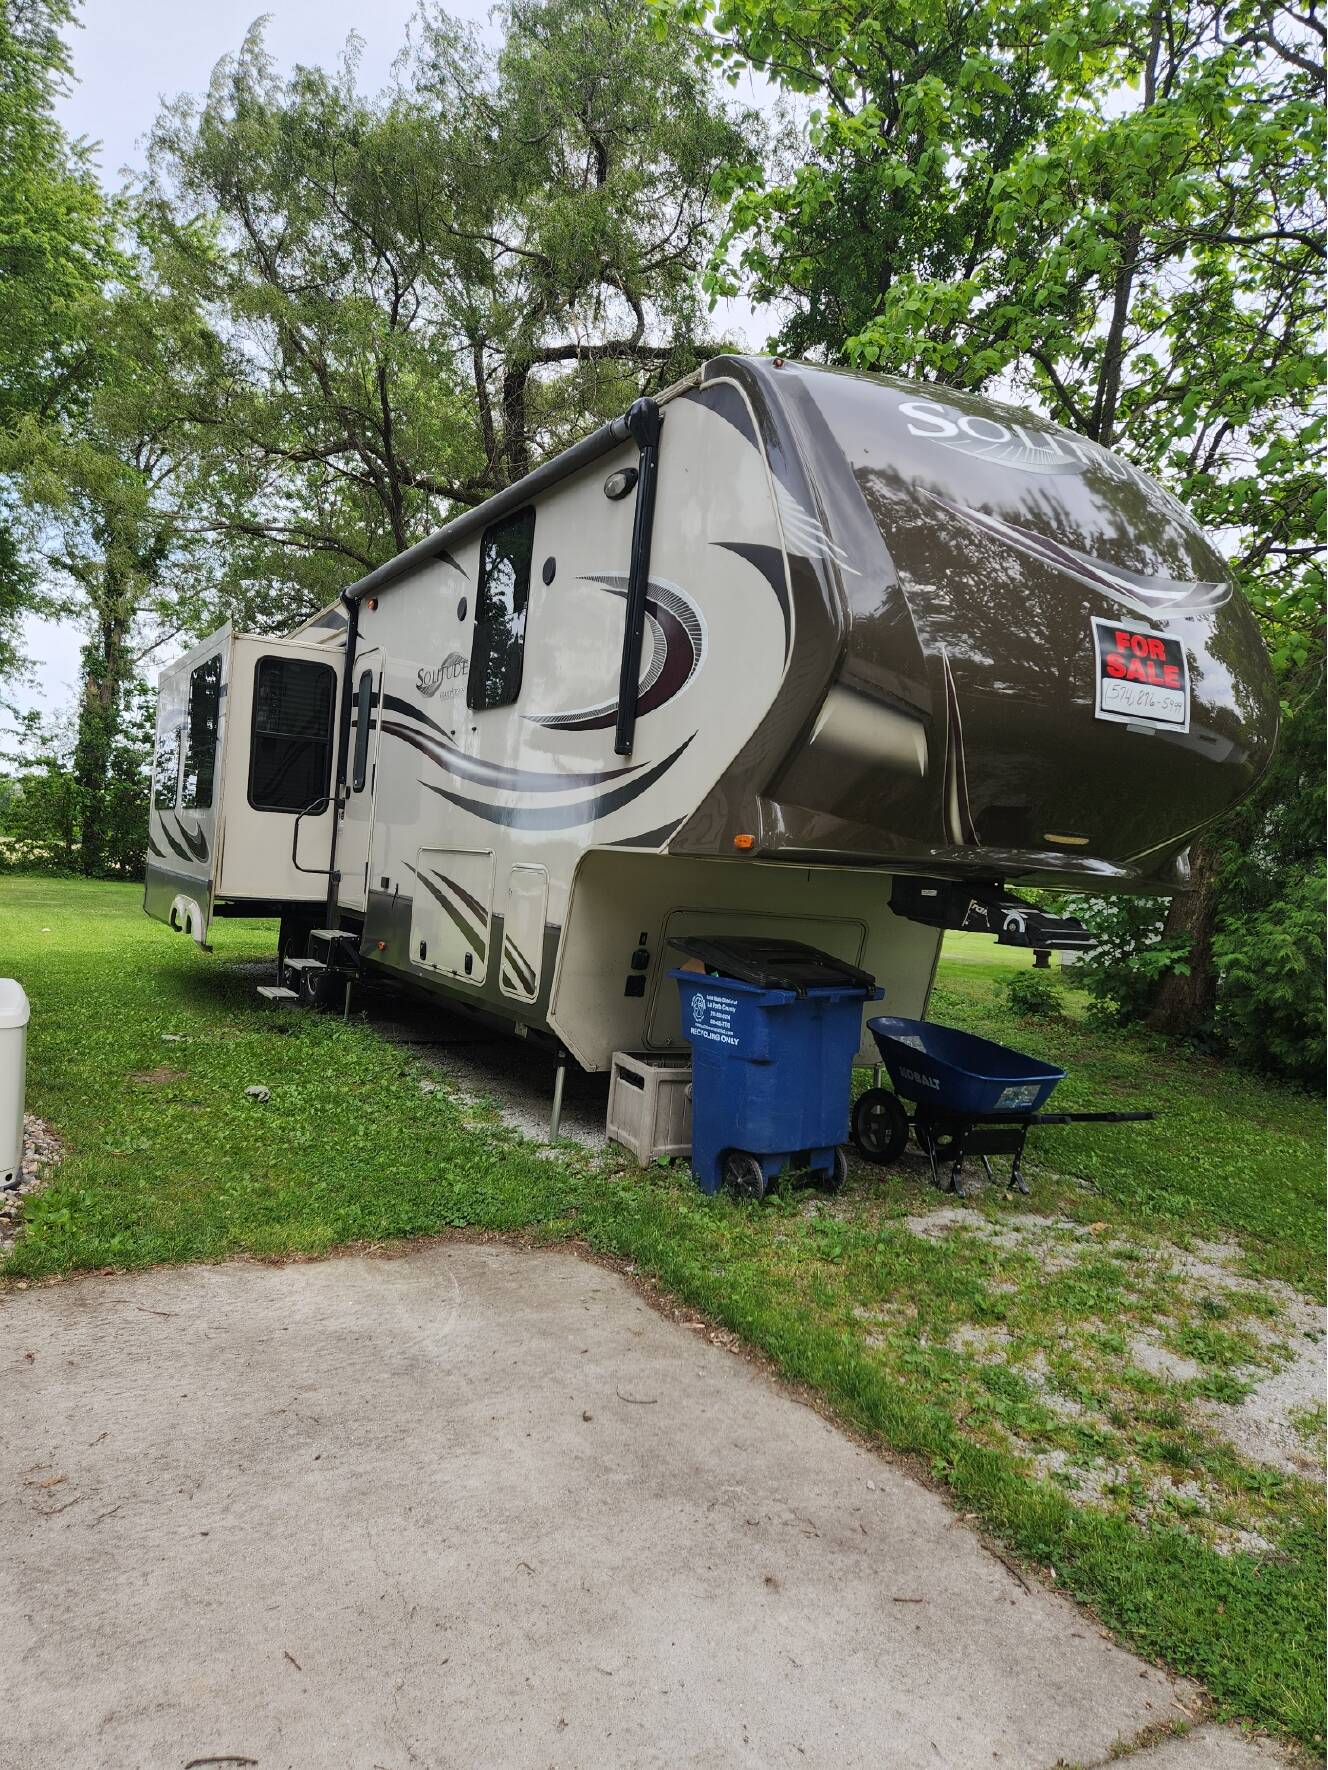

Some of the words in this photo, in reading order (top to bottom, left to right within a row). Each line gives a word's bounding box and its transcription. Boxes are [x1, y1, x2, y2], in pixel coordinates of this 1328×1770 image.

[1115, 631, 1167, 661] FOR
[416, 659, 468, 688] SOLITUDE
[1106, 653, 1181, 689] SALE
[690, 1027, 720, 1040] RECYCLING
[720, 1035, 739, 1045] ONLY
[899, 1066, 941, 1090] KOBALT
